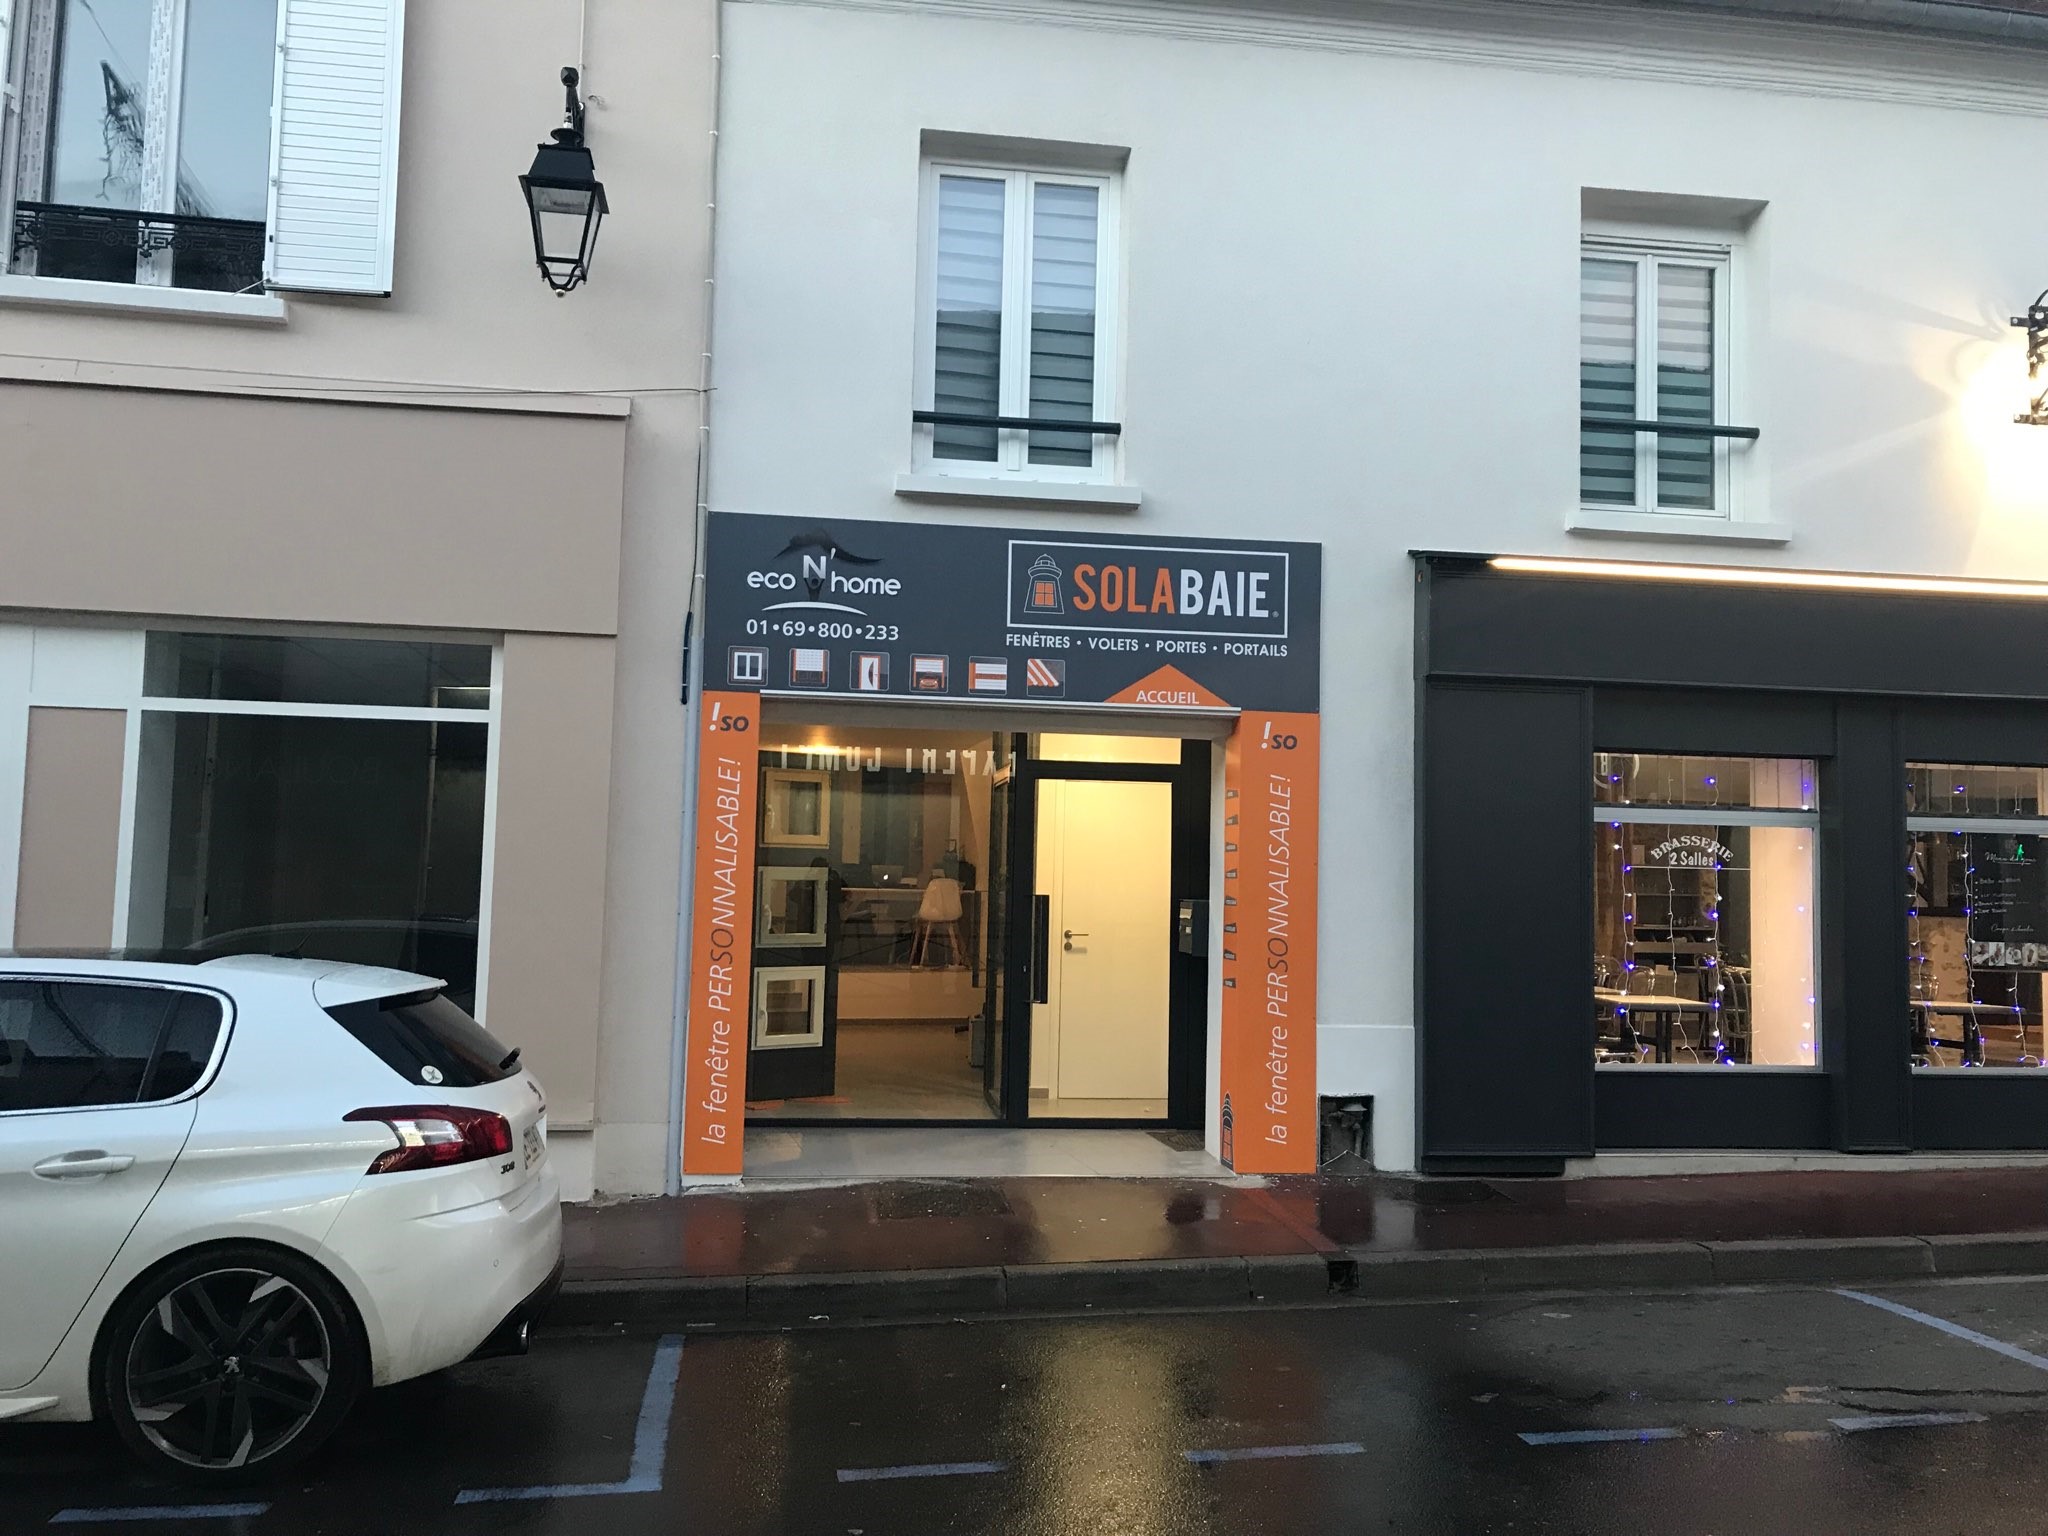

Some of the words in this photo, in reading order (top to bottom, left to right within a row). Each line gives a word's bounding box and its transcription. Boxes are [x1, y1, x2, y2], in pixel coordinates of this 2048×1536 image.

[747, 571, 796, 590] eco
[1073, 563, 1270, 618] SOLABAIE
[1006, 631, 1071, 649] FENÊTRES
[1088, 637, 1139, 651] VOLETS
[1156, 640, 1207, 654] PORTES
[1224, 643, 1288, 657] PORTAILS
[1136, 689, 1200, 705] ACCUEIL
[1650, 835, 1734, 862] BRASSERIE
[1669, 851, 1678, 865] 2
[1680, 851, 1714, 866] Salles
[702, 1020, 731, 1114] fenêtre
[1264, 1025, 1289, 1115] fenêtre
[701, 1124, 727, 1145] la
[1264, 1125, 1288, 1145] la
